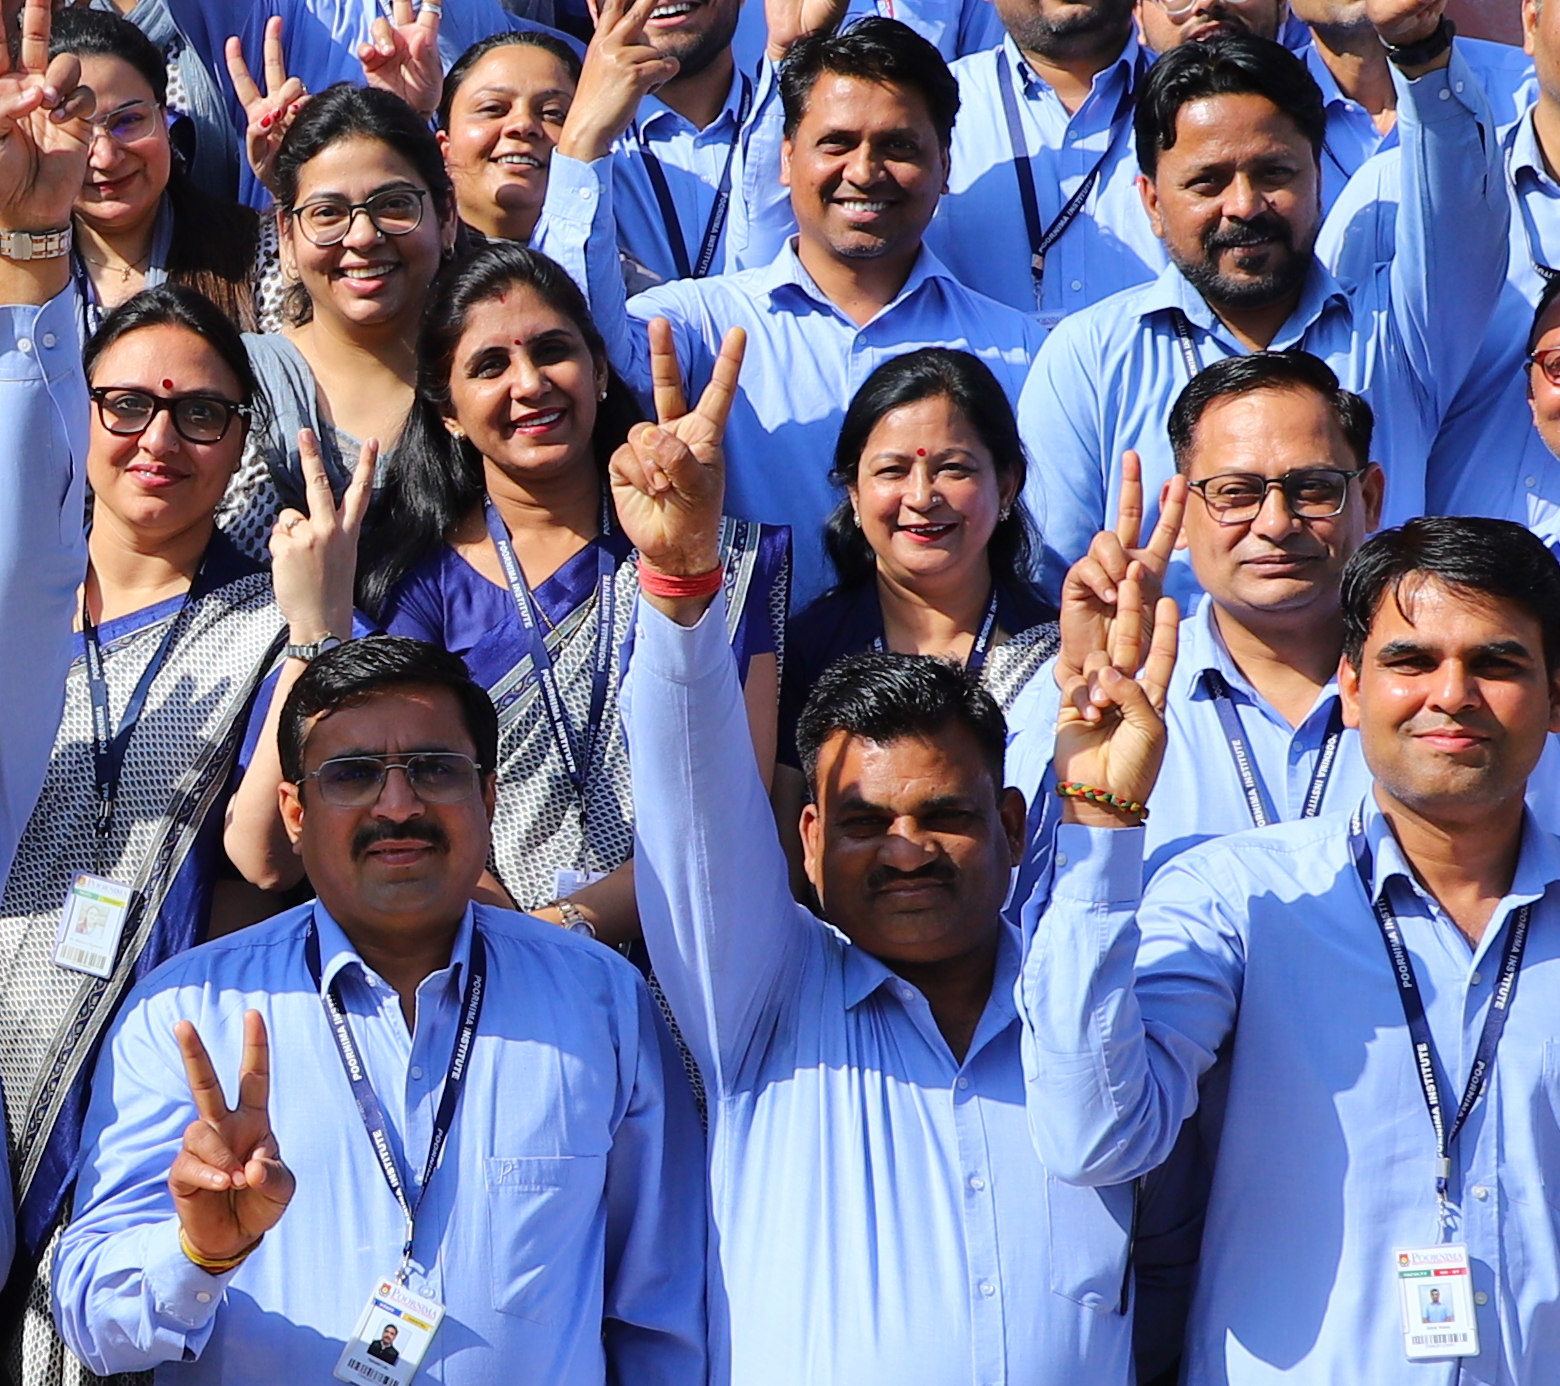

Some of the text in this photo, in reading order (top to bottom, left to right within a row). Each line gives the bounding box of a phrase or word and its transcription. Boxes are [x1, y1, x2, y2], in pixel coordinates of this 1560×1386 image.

[698, 192, 729, 275] POORNIMA INSTITUTE
[1038, 179, 1093, 254] POORNIMA INSTITUTE
[497, 540, 534, 629] POORNIMA INSTITUTE
[597, 574, 611, 673] POORNIMA INSTITUTE
[95, 704, 108, 755] POORNIMA
[540, 668, 576, 774] POORNIMA INSTITUTE
[1232, 739, 1266, 828] ORNIMA INSTITUTE
[1305, 778, 1325, 820] INSTITU
[1387, 931, 1412, 989] POORNIMA
[1493, 952, 1520, 1011] INSTITUTE
[336, 1023, 363, 1082] POORNIMA
[451, 974, 482, 1081] POORNIMA INSTITUTE
[1417, 1042, 1439, 1105] INSTITUTE
[372, 1129, 402, 1193] INSTITUTE
[392, 1287, 438, 1318] POORNIMA
